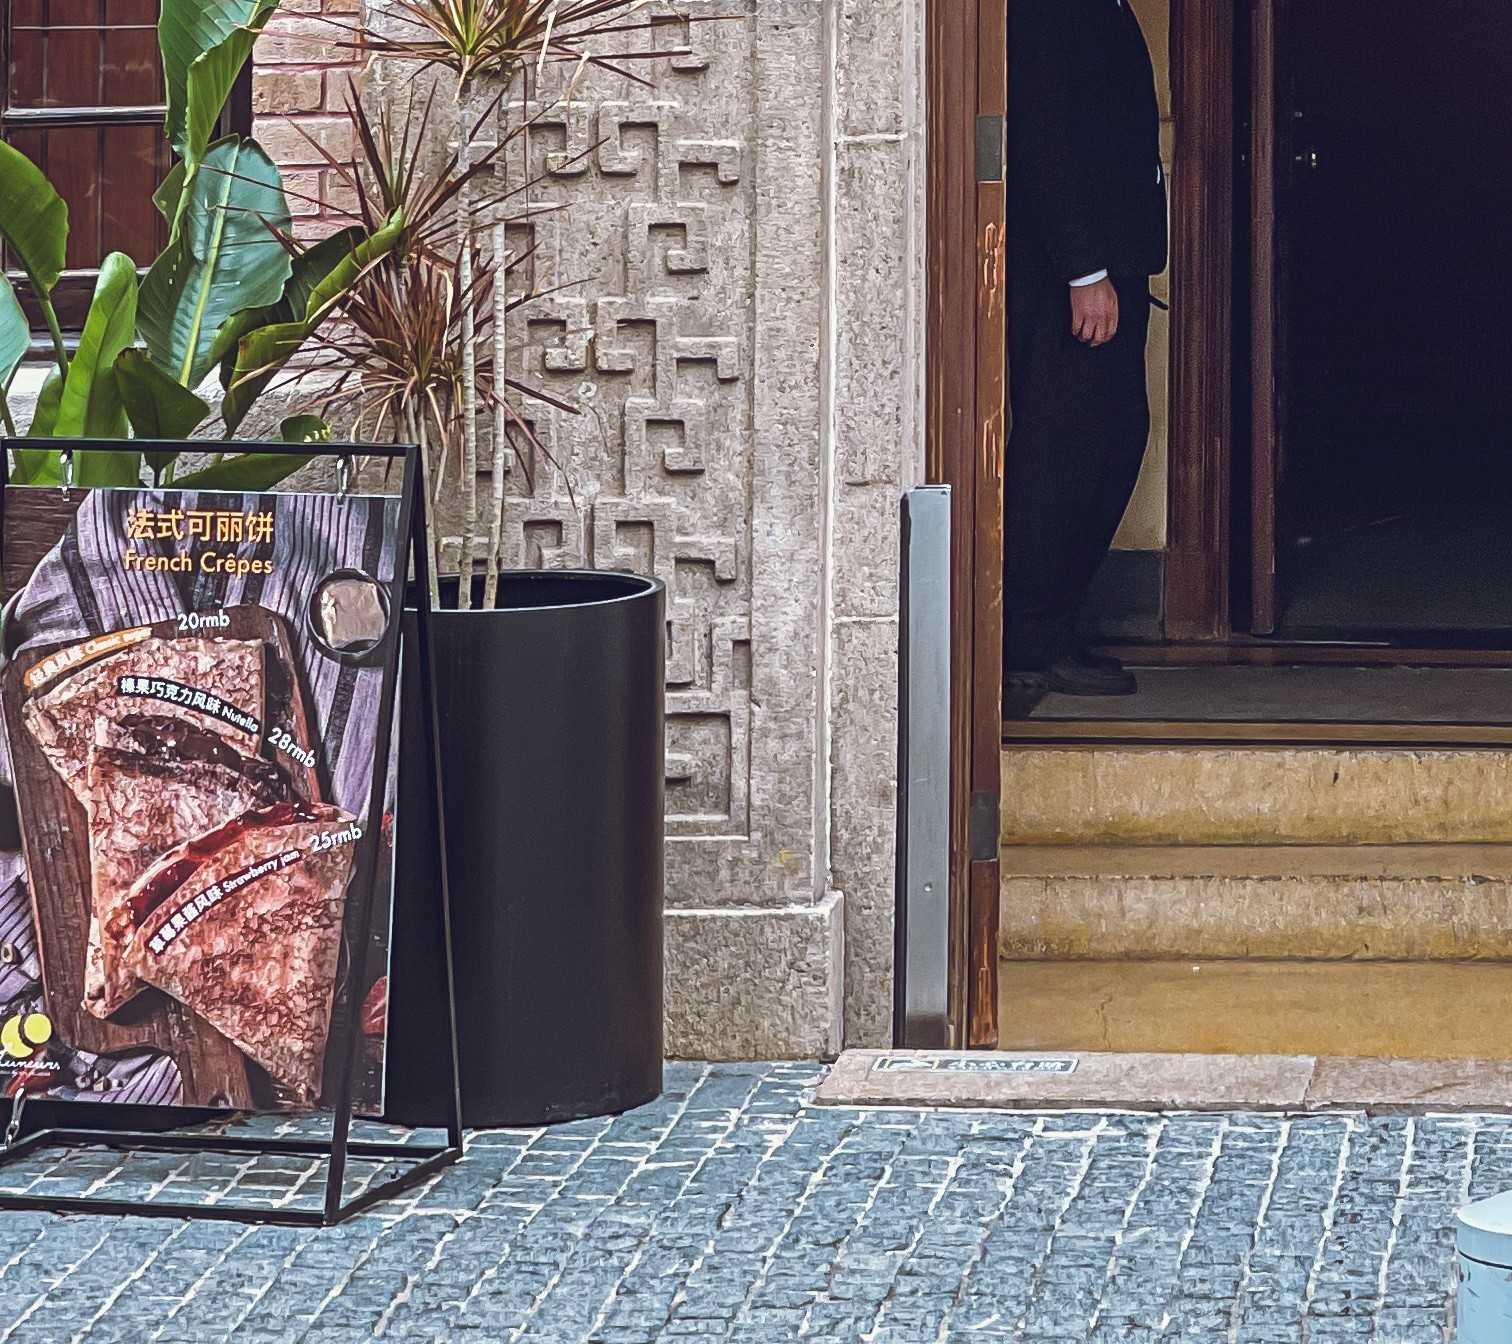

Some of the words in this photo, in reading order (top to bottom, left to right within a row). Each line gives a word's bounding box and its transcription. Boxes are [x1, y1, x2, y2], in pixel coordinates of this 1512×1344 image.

[127, 509, 275, 543] 法式可丽饼
[125, 549, 192, 572] French
[200, 551, 273, 578] Crêpes
[177, 609, 230, 631] 20rmb
[221, 705, 259, 733] Nutella
[267, 727, 316, 768] 28rmb
[308, 823, 362, 853] 25rmb
[222, 857, 279, 893] Strawberry
